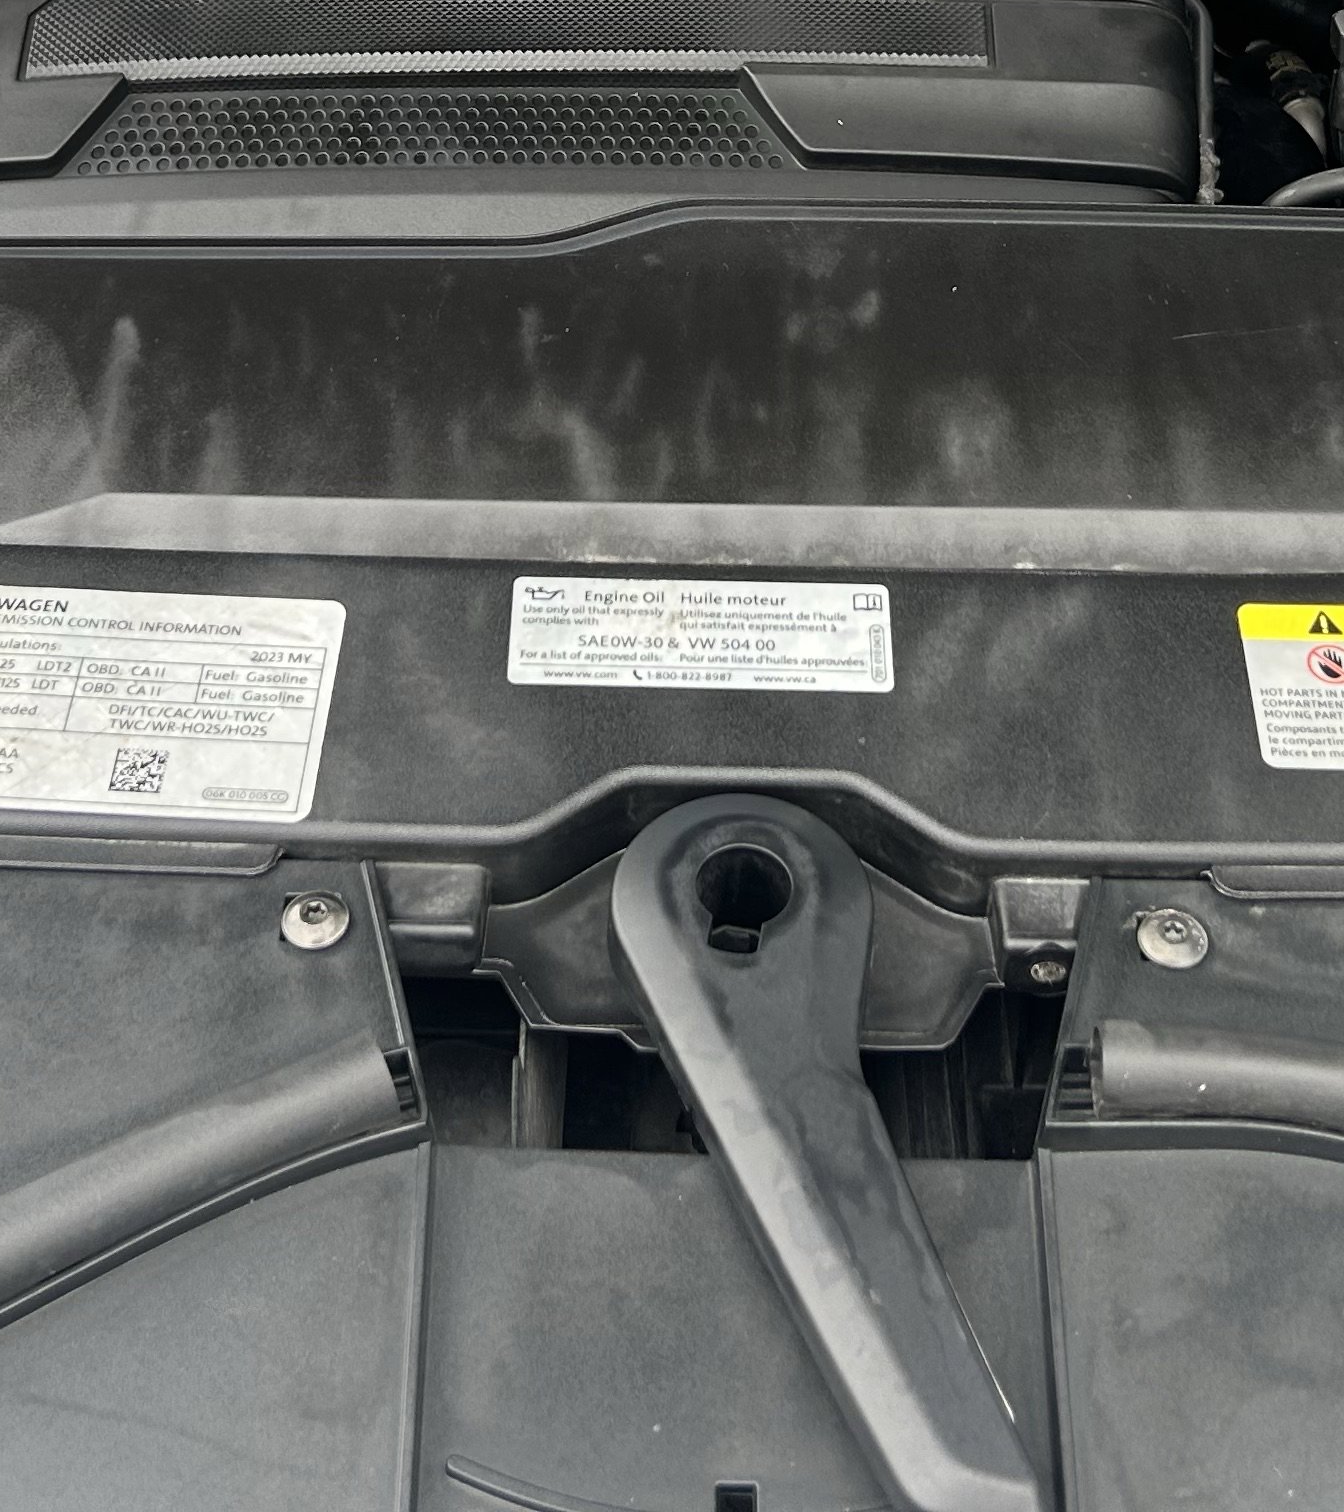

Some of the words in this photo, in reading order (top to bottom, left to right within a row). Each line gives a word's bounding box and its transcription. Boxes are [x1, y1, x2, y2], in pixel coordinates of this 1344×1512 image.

[585, 590, 638, 605] Engine
[643, 591, 665, 603] Oil
[681, 592, 723, 605] Huile
[727, 594, 786, 606] moteur
[524, 604, 544, 613] Use
[546, 605, 569, 616] only
[572, 606, 585, 614] oil
[588, 606, 610, 615] that
[614, 607, 664, 617] expressly
[680, 609, 721, 619] Utilisez
[725, 610, 793, 622] uniquement
[796, 612, 810, 621] de
[68, 616, 135, 631] CONTROL
[140, 621, 242, 636] INFORMATION
[522, 616, 571, 626] complies
[575, 617, 599, 626] with
[679, 621, 698, 632] qui
[701, 622, 745, 631] satisfait
[748, 622, 827, 634] expressément
[831, 623, 837, 632] à
[668, 638, 679, 649] &
[688, 637, 716, 649] VW
[721, 638, 750, 651] 504
[755, 639, 776, 651] 00
[251, 651, 284, 662] 2023
[288, 652, 313, 664] MY
[520, 650, 538, 658] For
[551, 650, 566, 660] list
[570, 651, 582, 660] of
[584, 652, 636, 662] approved
[680, 653, 704, 662] Pour
[708, 655, 727, 664] une
[731, 654, 754, 664] liste
[37, 660, 72, 672] LDT2
[131, 666, 152, 677] CA
[247, 671, 308, 685] Gasoline
[544, 670, 618, 679] www.vw.com
[753, 674, 816, 684] www.vw.ca
[32, 679, 59, 691] LDT
[126, 684, 147, 696] CA
[242, 691, 305, 704] Gasoline
[1260, 687, 1283, 697] HOT
[1287, 688, 1322, 698] PARTS
[1326, 689, 1337, 698] IN
[1264, 709, 1312, 720] MOVING
[1266, 723, 1336, 735] Composants
[1269, 735, 1279, 744] le
[1271, 746, 1308, 757] Pièces
[1312, 749, 1326, 757] en
